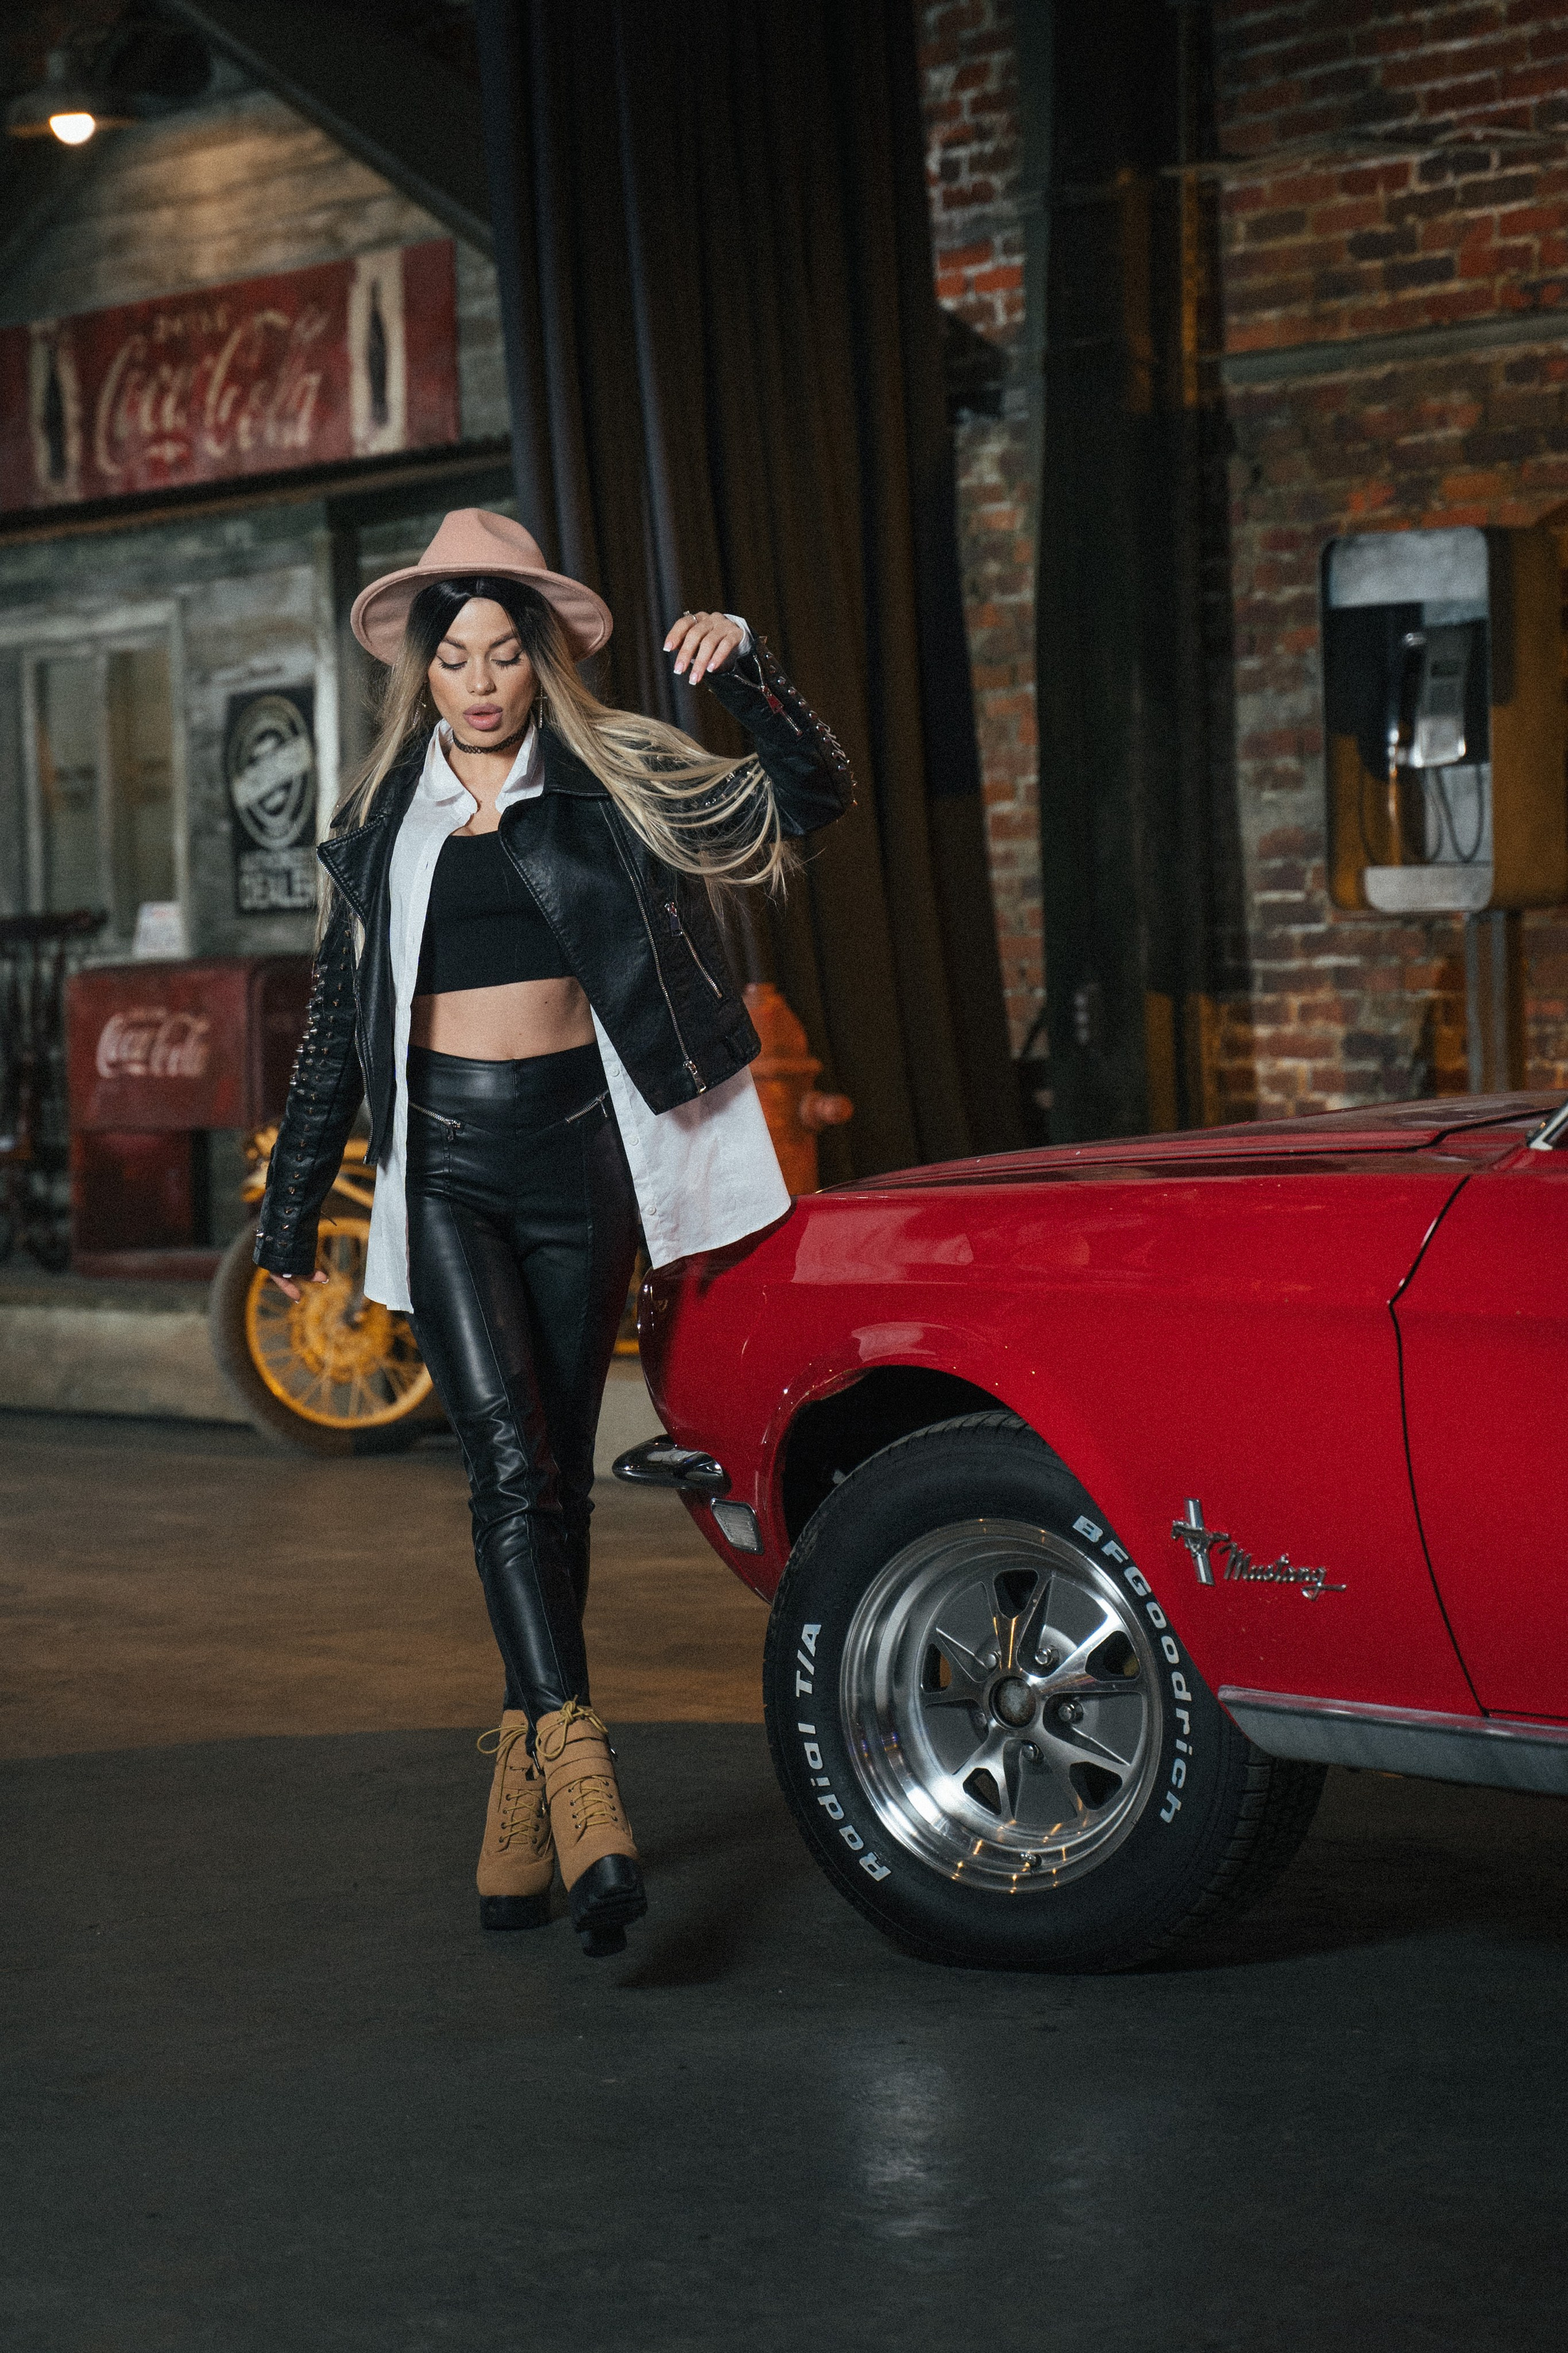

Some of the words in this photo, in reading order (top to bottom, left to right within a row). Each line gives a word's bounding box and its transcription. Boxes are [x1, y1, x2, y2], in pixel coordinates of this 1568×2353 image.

[1217, 1542, 1348, 1601] Mustang
[796, 1624, 822, 1698] T/A
[1072, 1515, 1193, 1824] BFGoodrich
[797, 1722, 892, 1882] Radial
